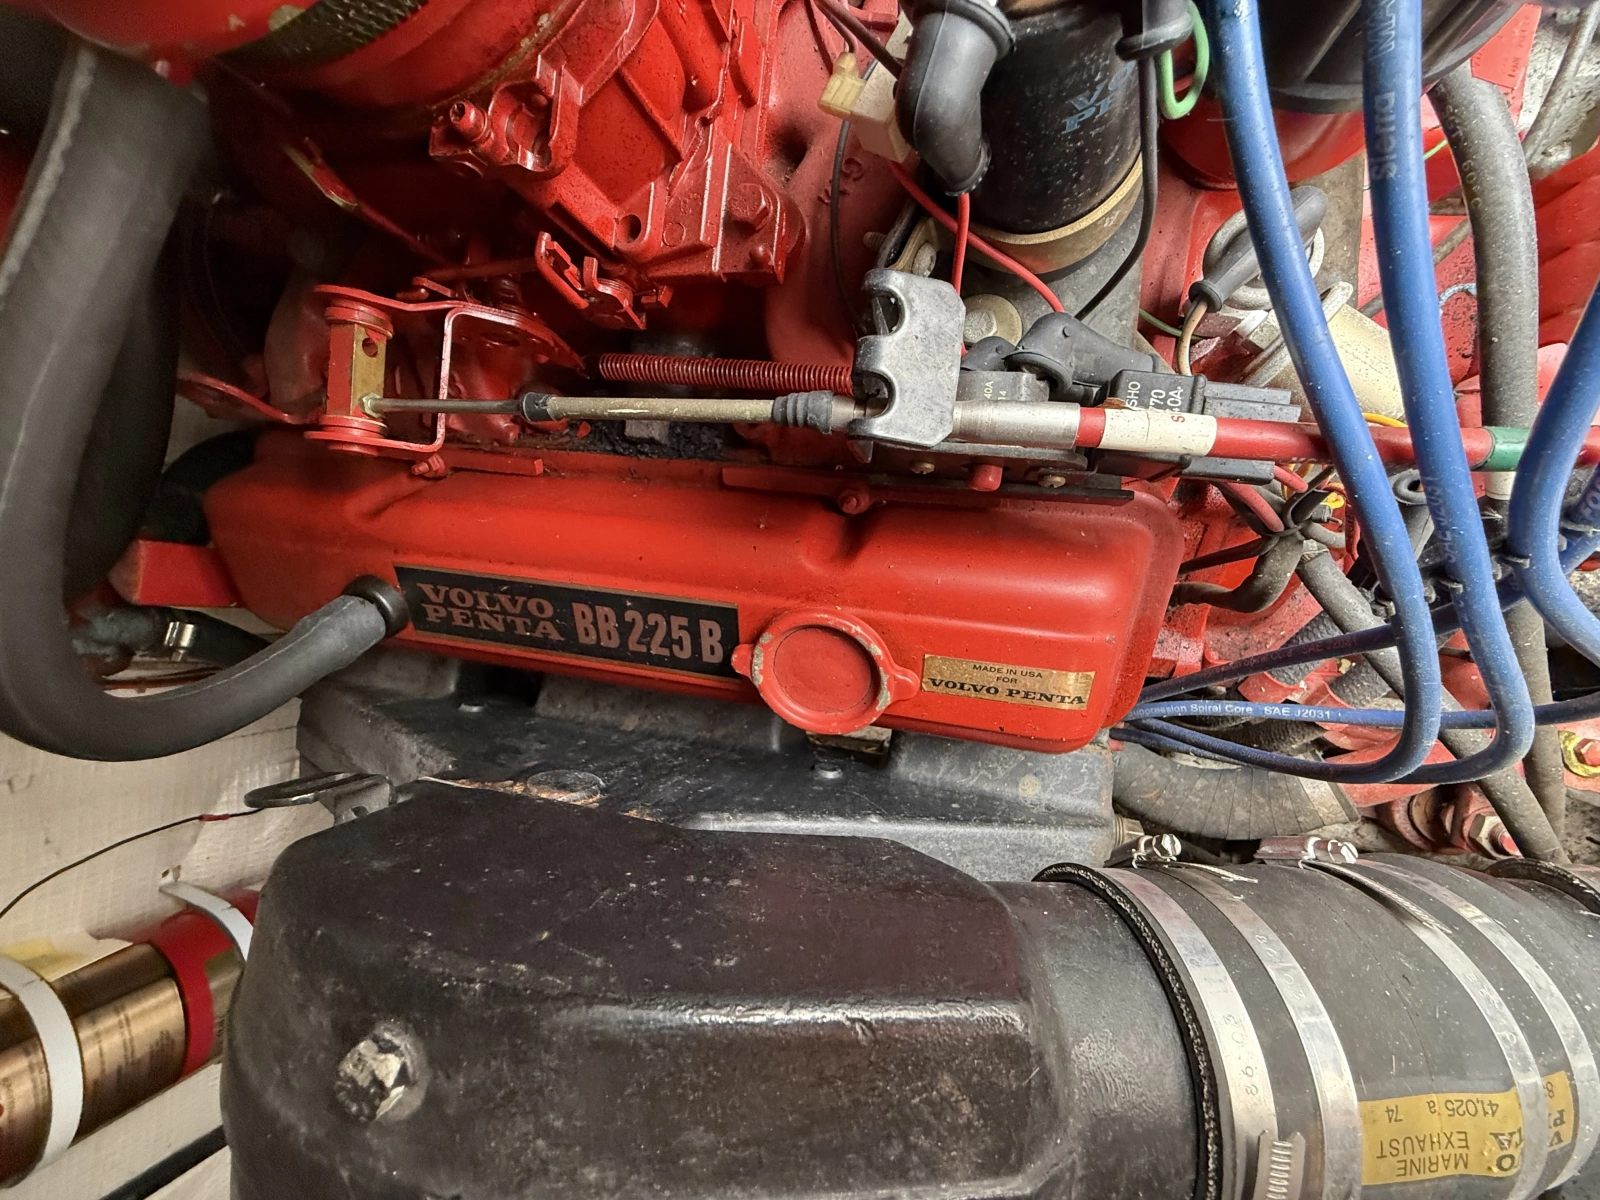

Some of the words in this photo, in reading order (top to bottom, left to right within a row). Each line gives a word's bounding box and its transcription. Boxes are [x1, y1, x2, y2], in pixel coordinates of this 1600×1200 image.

[416, 583, 554, 619] VOLVO
[421, 603, 565, 641] PENTA
[972, 664, 1003, 674] MADE
[1005, 668, 1018, 676] IN
[1020, 670, 1043, 679] USA
[996, 676, 1018, 685] FOR
[928, 677, 1000, 696] VOLVO
[1005, 688, 1085, 705] PENTA
[1190, 703, 1222, 717] Spiral
[1225, 704, 1253, 715] Core
[1263, 705, 1291, 718] SAE
[1293, 708, 1332, 720] J2031
[1385, 1105, 1404, 1124] 74
[1444, 1099, 1499, 1118] 41,025
[1376, 1130, 1470, 1159] EXHAUST
[1396, 1152, 1469, 1178] MARINE
